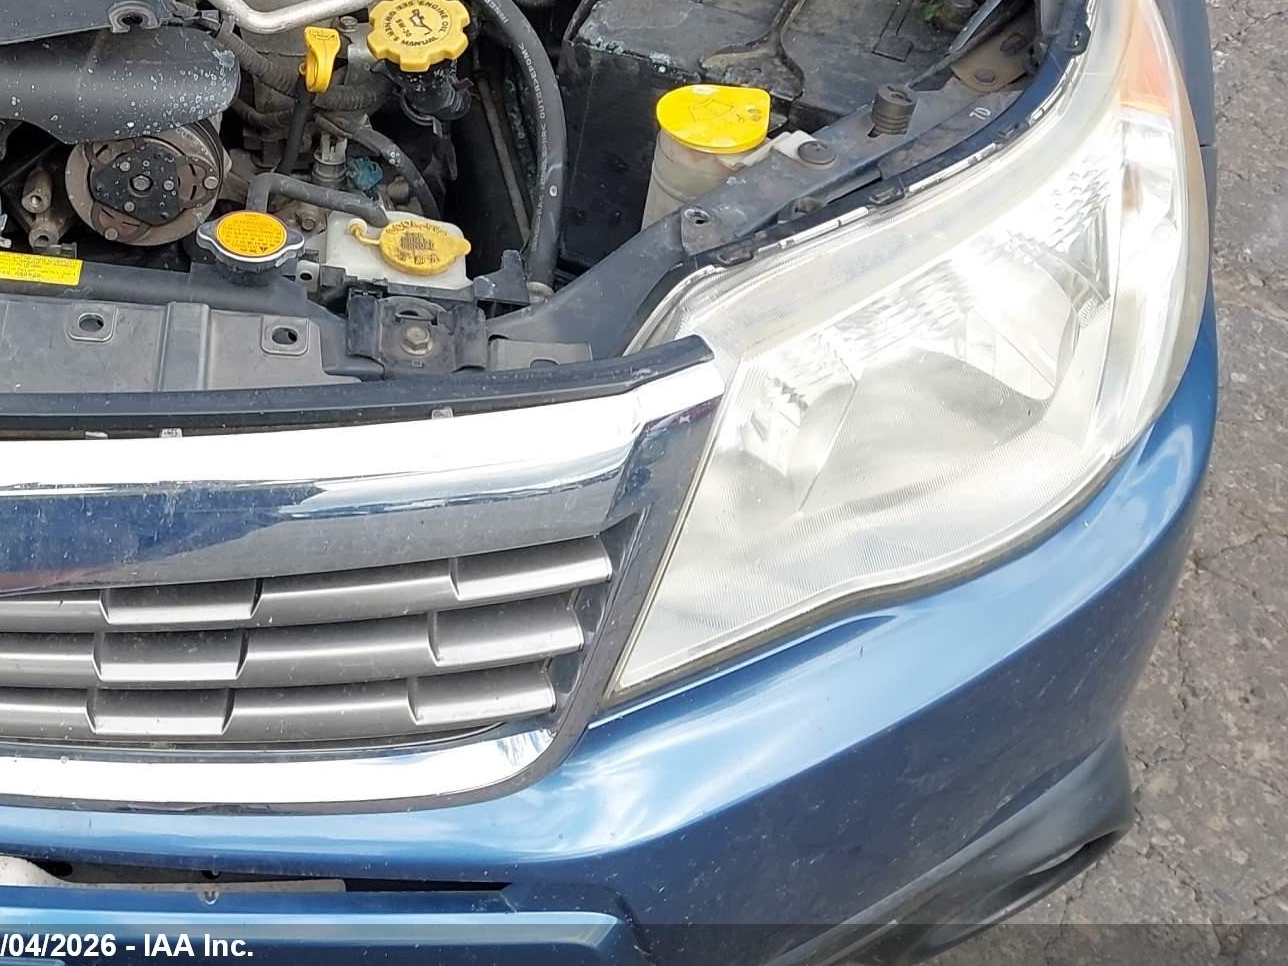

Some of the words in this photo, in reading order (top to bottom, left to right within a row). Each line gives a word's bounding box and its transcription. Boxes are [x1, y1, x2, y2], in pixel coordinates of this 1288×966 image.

[419, 0, 450, 21] ENGINE
[439, 20, 450, 33] OIL
[400, 36, 440, 47] MANUAL
